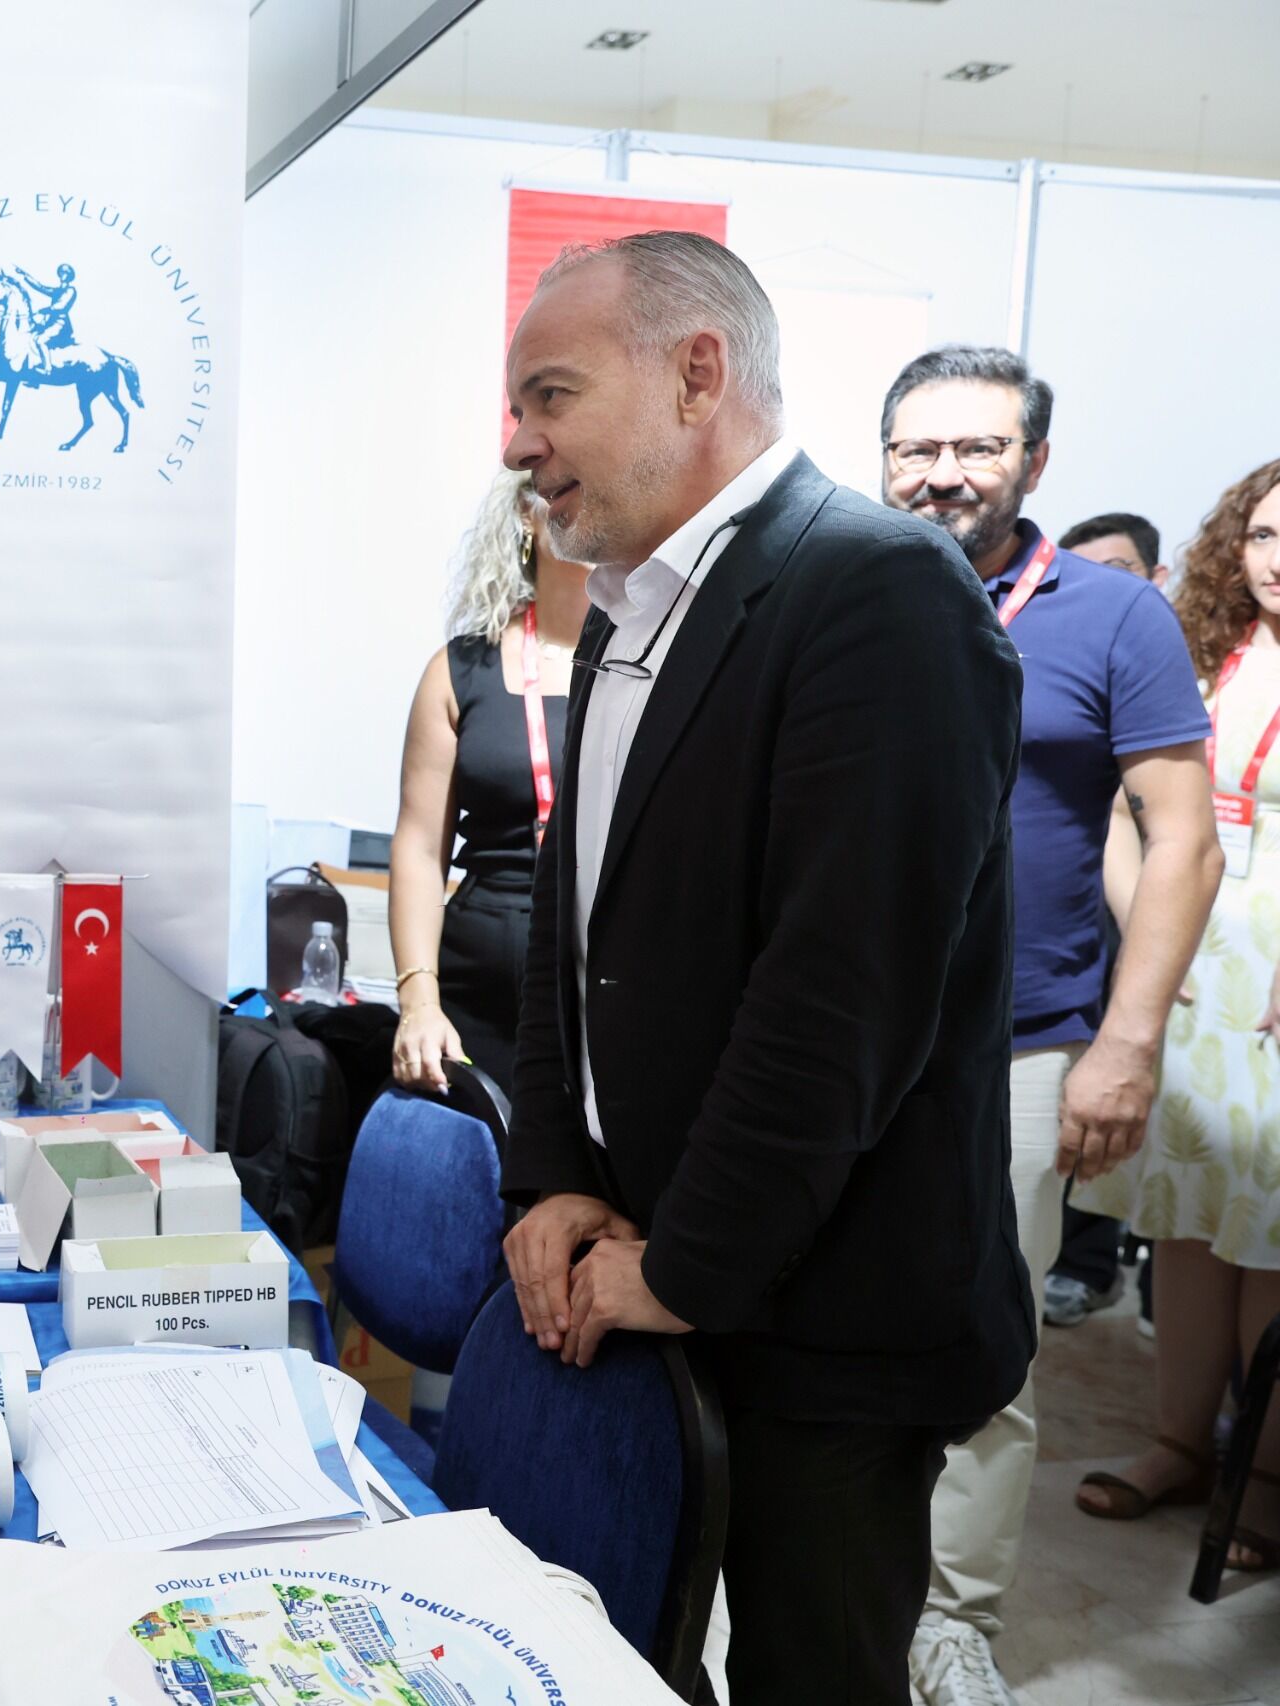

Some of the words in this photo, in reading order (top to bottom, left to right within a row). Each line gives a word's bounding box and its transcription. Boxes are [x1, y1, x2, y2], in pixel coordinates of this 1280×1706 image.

[34, 192, 135, 240] EYLÜL
[150, 243, 212, 485] ÜNİVERSİTESİ
[87, 1295, 137, 1310] PENCIL
[141, 1291, 200, 1307] RUBBER
[204, 1288, 253, 1303] TIPPED
[256, 1287, 276, 1301] HB
[155, 1318, 178, 1331] 100
[182, 1316, 210, 1330] Pcs.
[155, 1577, 215, 1594] DOKUZ
[218, 1567, 274, 1585] EYLÜL
[280, 1568, 392, 1594] UNIVERSITY
[400, 1592, 467, 1622] DOKUZ
[466, 1617, 516, 1649] EYLÜL
[514, 1647, 567, 1706] ÜNİVERS
